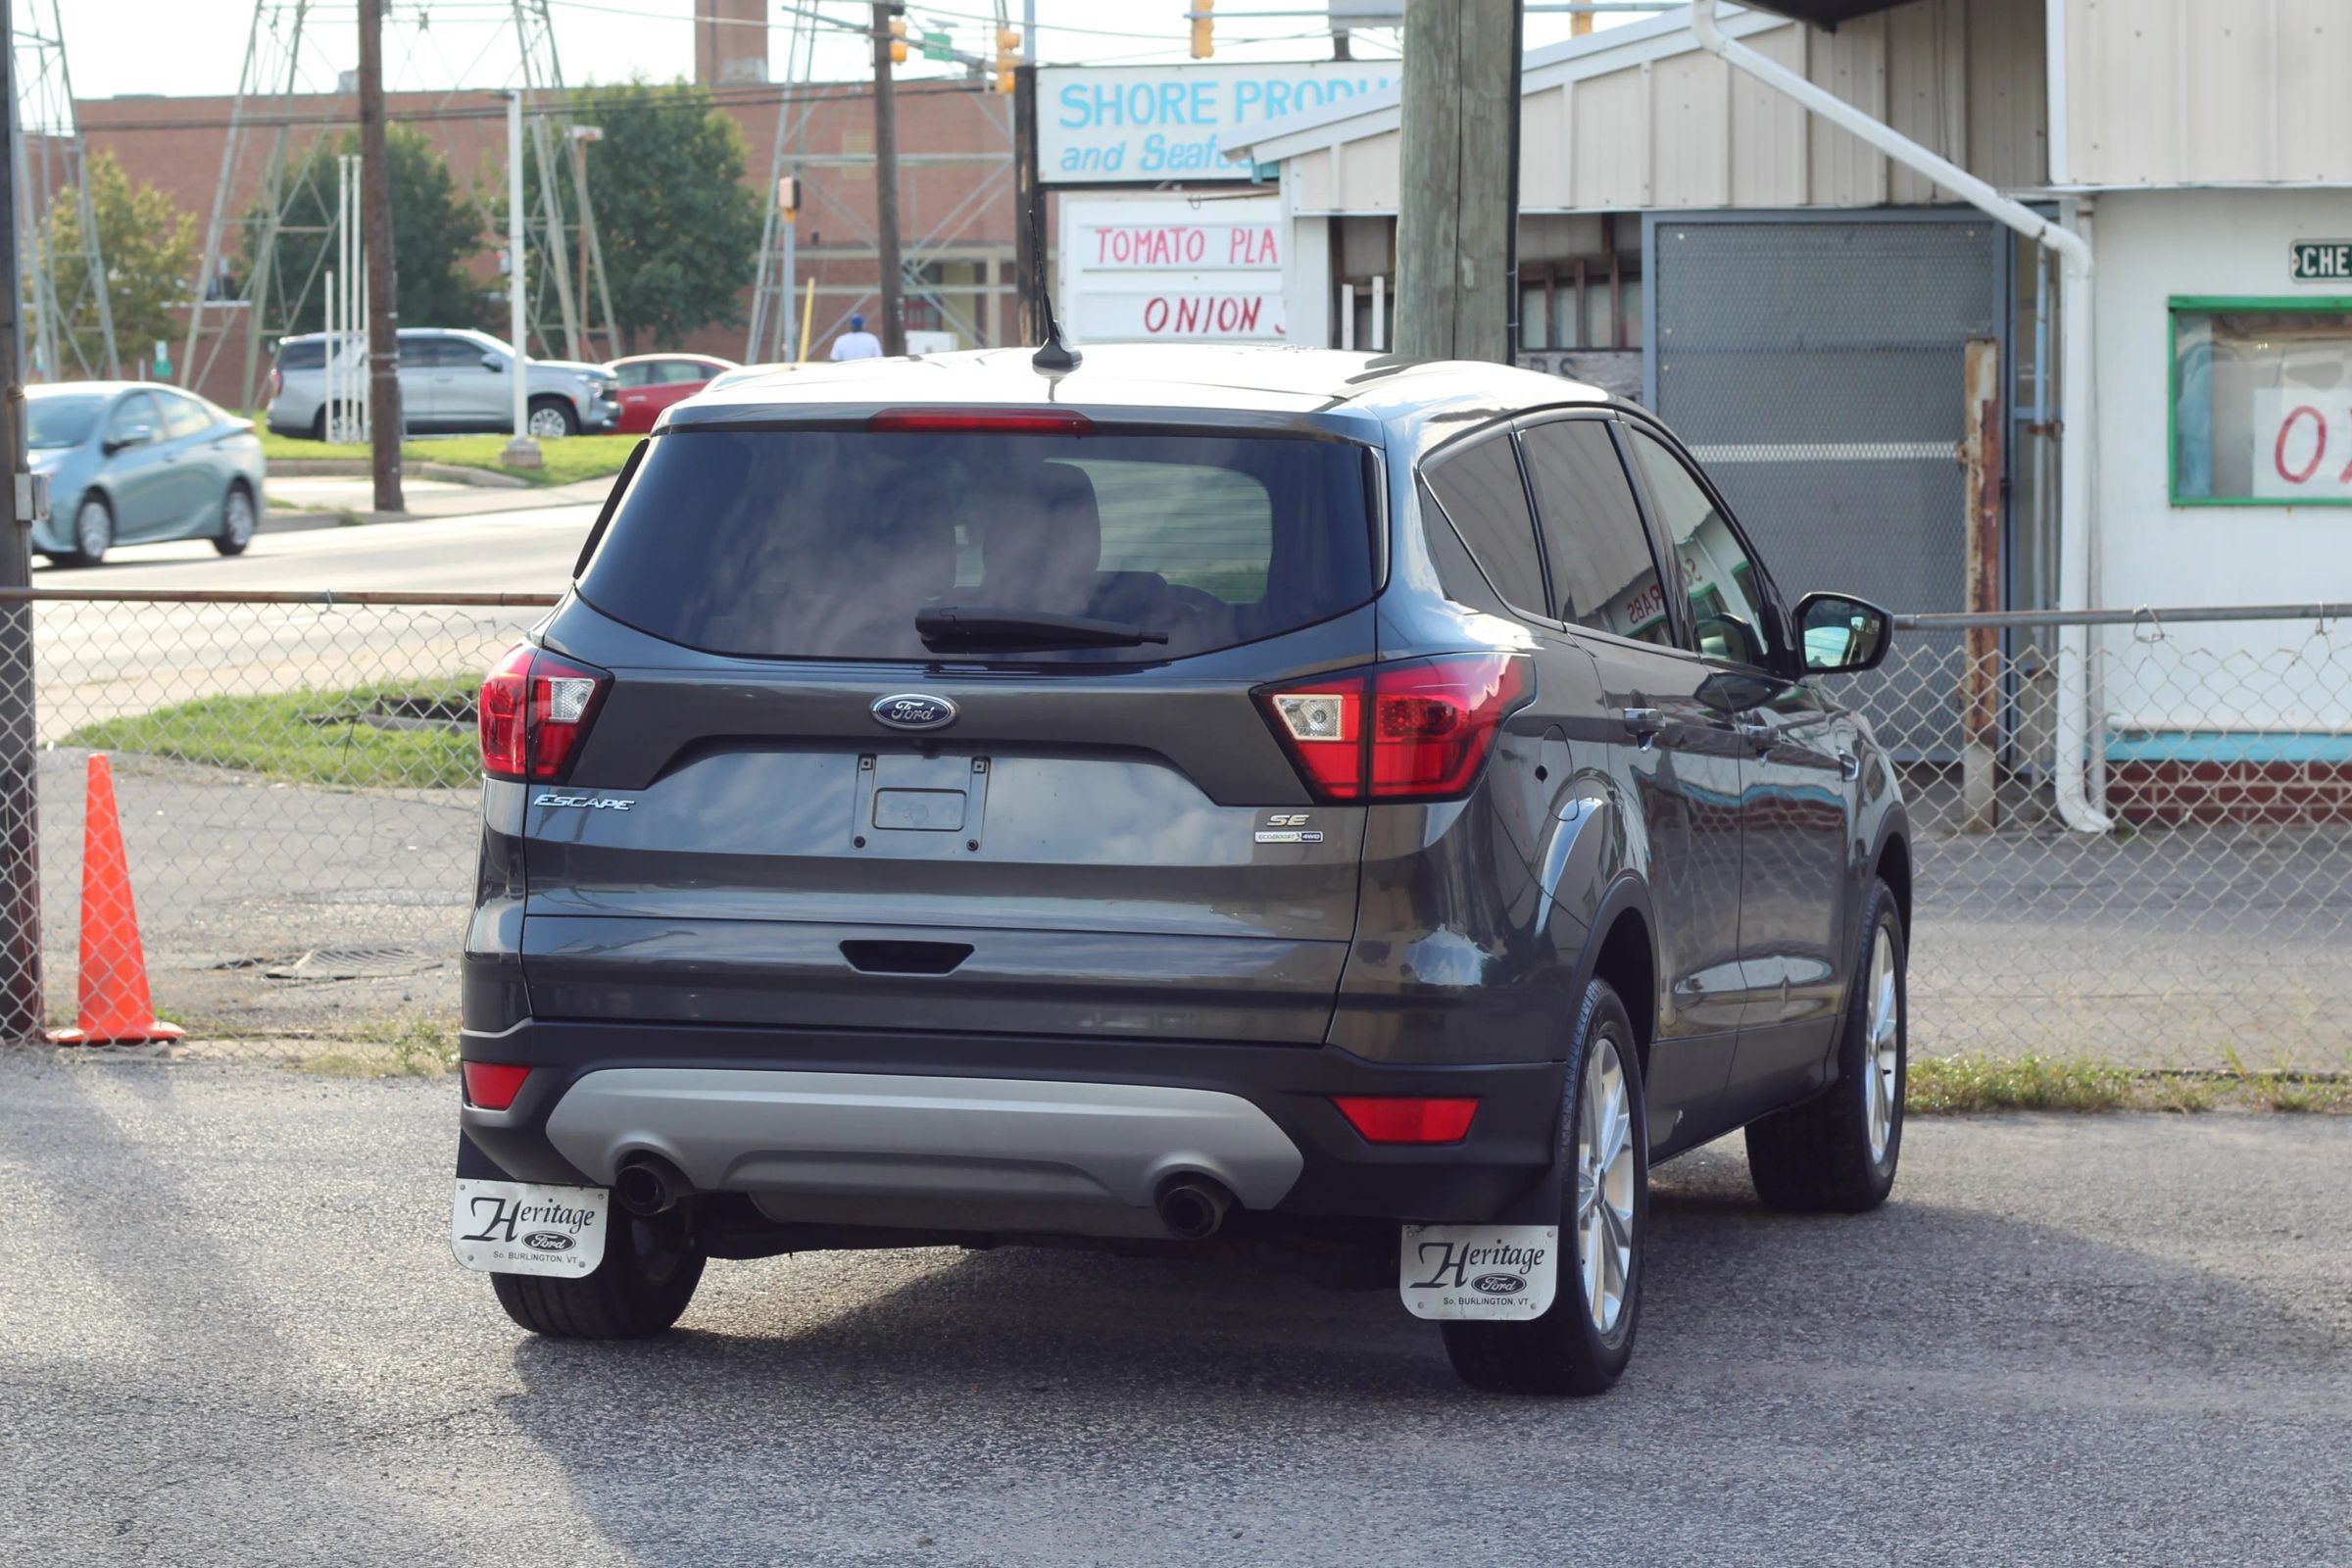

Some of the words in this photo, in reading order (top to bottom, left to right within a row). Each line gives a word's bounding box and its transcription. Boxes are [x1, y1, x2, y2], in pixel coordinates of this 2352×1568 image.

[1058, 81, 1219, 129] SHORE
[1060, 140, 1127, 172] and
[1095, 227, 1204, 265] TOMATO
[1230, 228, 1278, 264] PLA
[2302, 247, 2352, 275] CHE
[1145, 297, 1262, 333] ONION
[891, 700, 936, 720] Ford
[533, 794, 635, 811] ESCAPE
[1266, 813, 1310, 826] SE
[460, 1196, 596, 1243] Heritage
[530, 1233, 566, 1250] Ford
[566, 1255, 578, 1264] VT
[1408, 1238, 1545, 1289] Heritage
[1481, 1275, 1516, 1292] Ford
[1458, 1297, 1516, 1307] BURLINGTON,
[1518, 1297, 1530, 1305] VT
